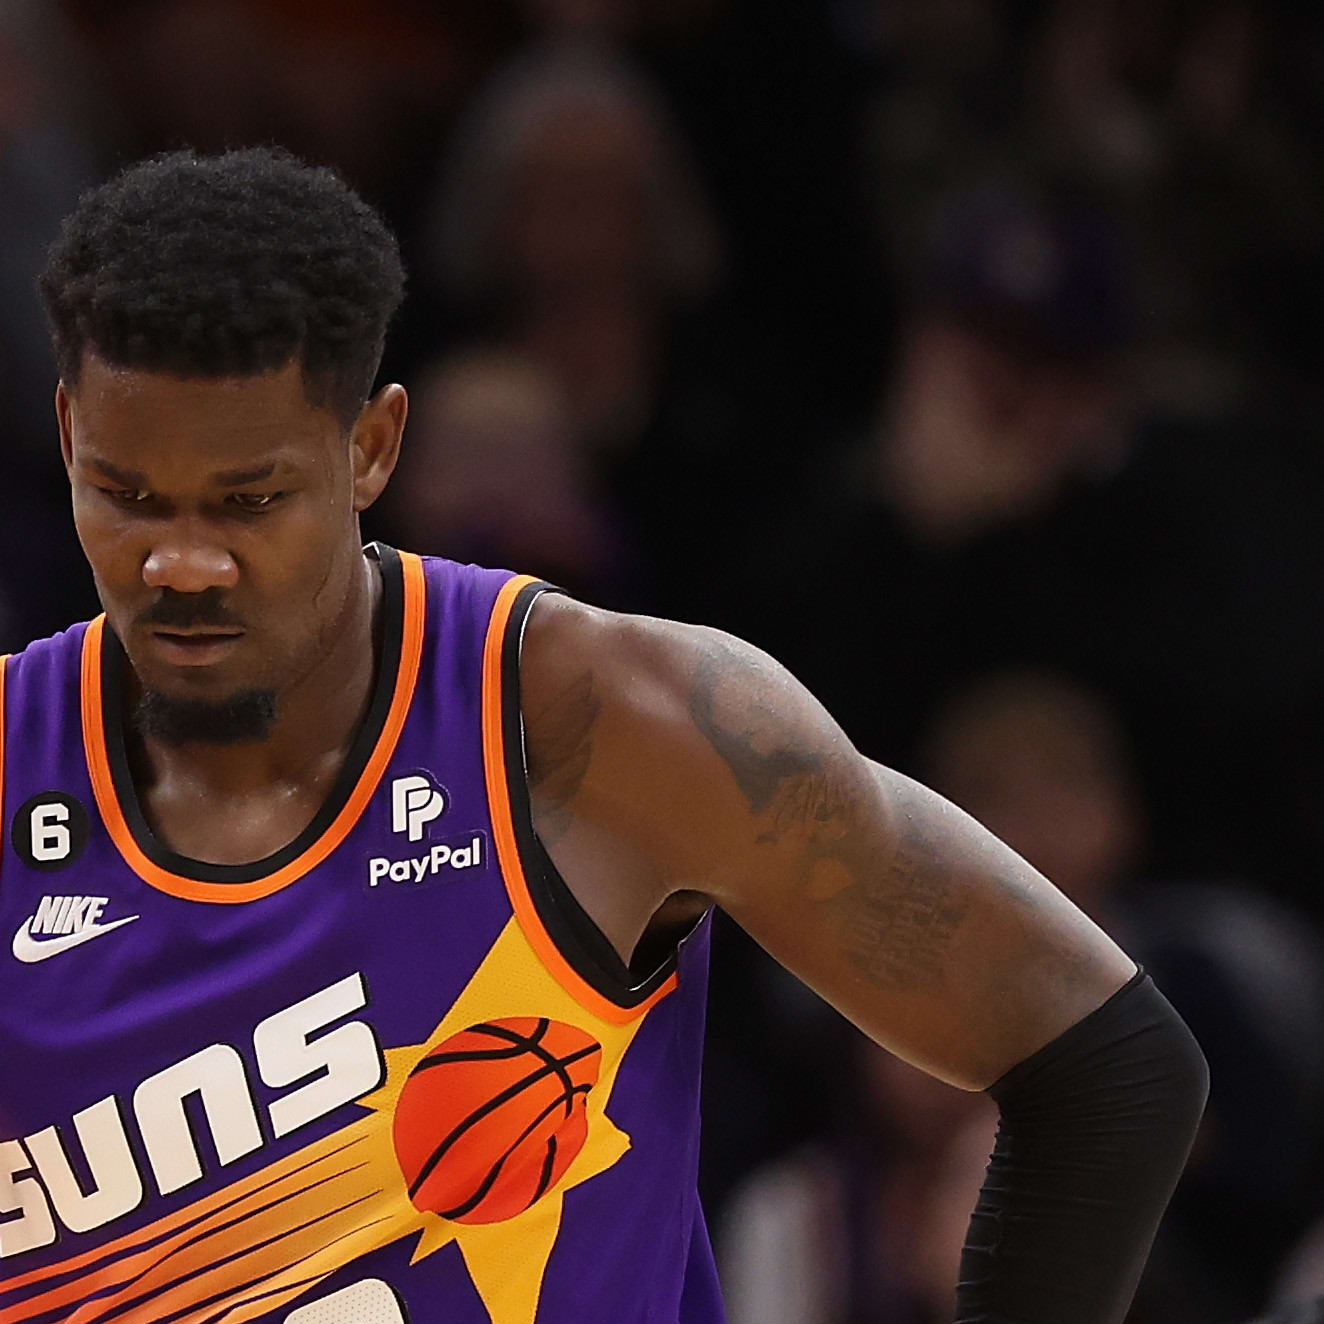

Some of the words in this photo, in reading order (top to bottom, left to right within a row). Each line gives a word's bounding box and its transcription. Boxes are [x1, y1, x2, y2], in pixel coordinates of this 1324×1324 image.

[30, 802, 70, 861] 6
[369, 836, 480, 887] PayPal
[30, 895, 110, 934] NIKE
